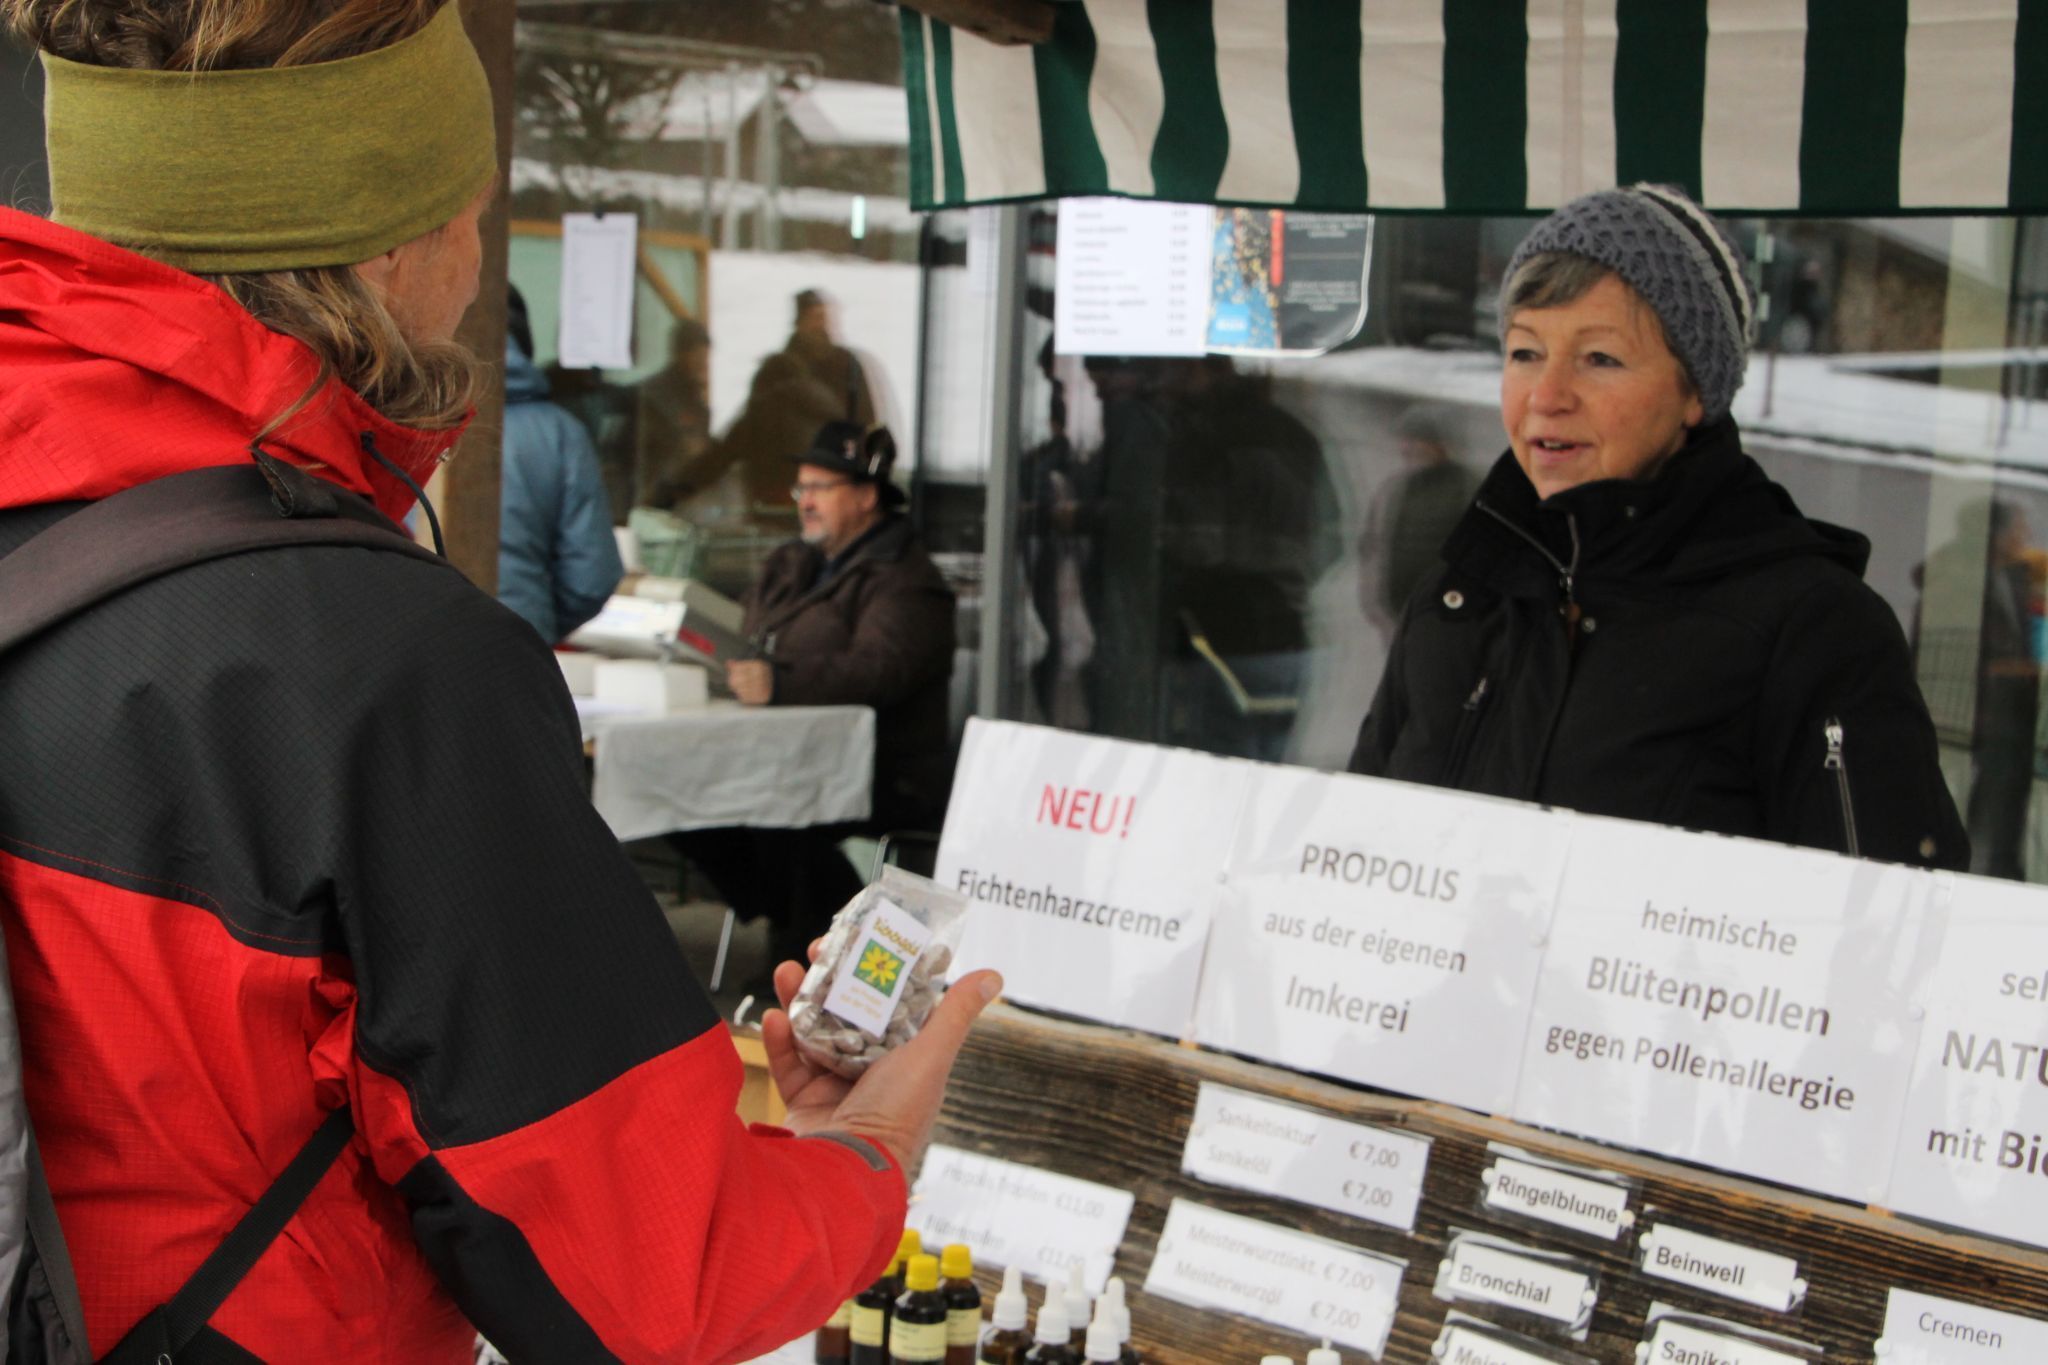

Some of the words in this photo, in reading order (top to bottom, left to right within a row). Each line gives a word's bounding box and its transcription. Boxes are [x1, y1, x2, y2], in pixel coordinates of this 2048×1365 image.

[1036, 783, 1137, 839] NEU!
[1300, 843, 1460, 902] PROPOLIS
[957, 867, 1181, 942] Fichtenharzcreme
[1641, 899, 1797, 956] heimische
[1264, 912, 1306, 938] aus
[1312, 916, 1356, 949] der
[1362, 928, 1467, 974] eigenen
[1285, 974, 1411, 1033] Imkerei
[1587, 956, 1831, 1037] Blütenpollen
[1546, 1025, 1625, 1060] gegen
[1633, 1036, 1855, 1111] Pollenallergie
[1927, 1128, 1987, 1163] mit
[1497, 1174, 1618, 1224] Ringelblume
[1458, 1264, 1552, 1305] Bronchial
[1656, 1246, 1745, 1286] Beinwell
[1918, 1311, 2003, 1349] Cremen
